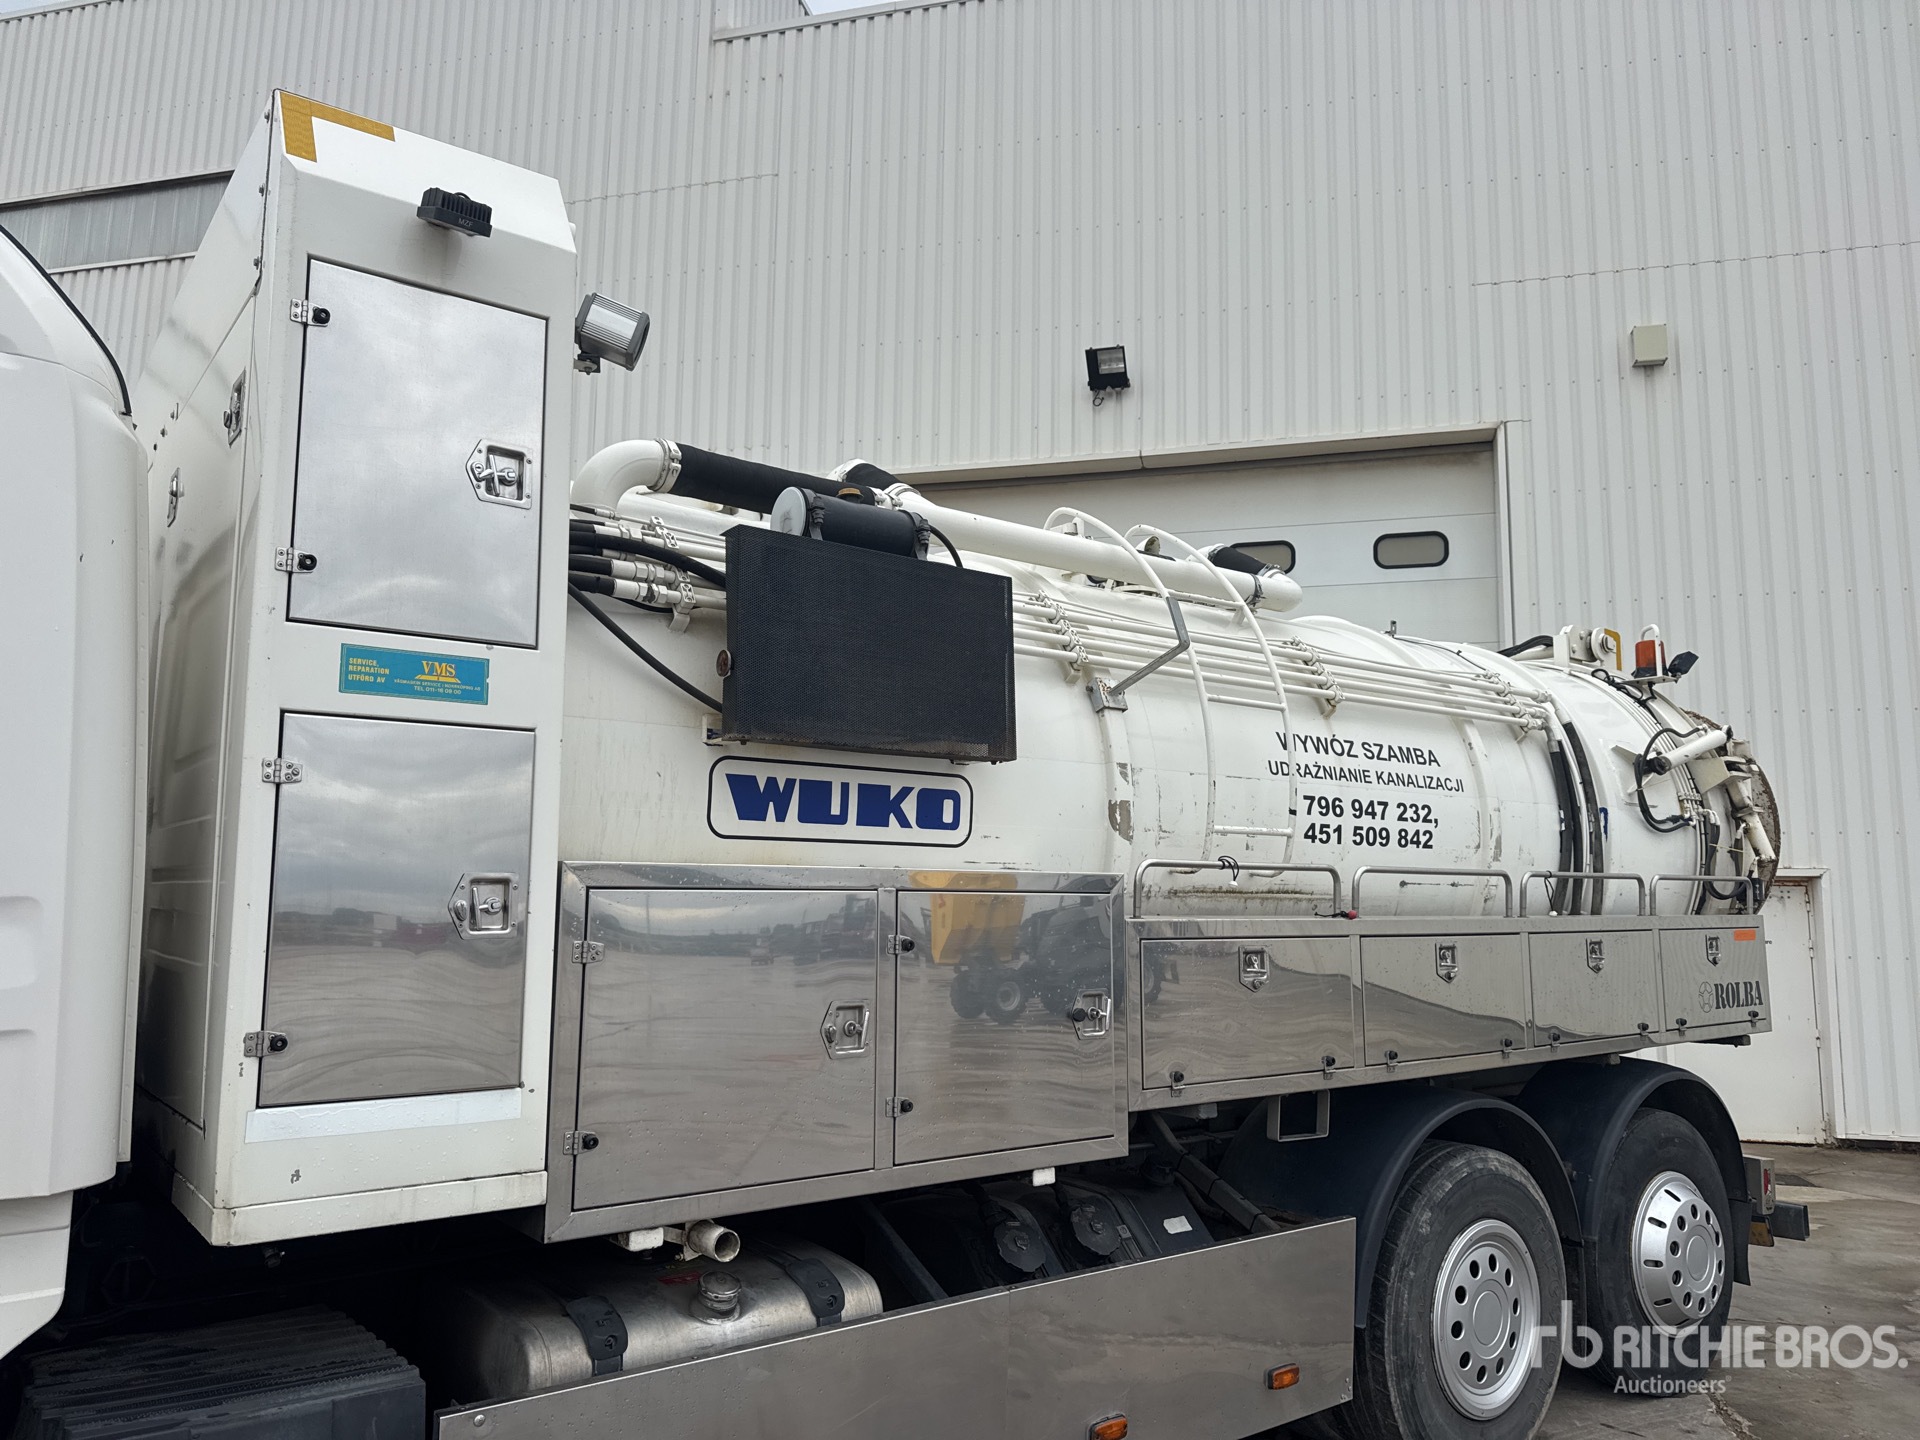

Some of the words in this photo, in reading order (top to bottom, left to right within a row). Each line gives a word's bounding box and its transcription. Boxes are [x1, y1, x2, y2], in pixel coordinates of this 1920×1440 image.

[348, 664, 390, 675] REPARATION
[422, 660, 456, 677] VMS
[1275, 732, 1359, 758] WYWÓZ
[1361, 741, 1441, 767] SZAMBA
[1375, 770, 1465, 793] KANALIZACJI
[725, 773, 961, 831] WUKO
[1303, 795, 1344, 818] 796
[1351, 799, 1389, 821] 947
[1396, 803, 1439, 828] 232,
[1303, 823, 1343, 845] 451
[1352, 826, 1391, 847] 509
[1397, 828, 1434, 849] 842
[1714, 981, 1763, 1010] ROLBA
